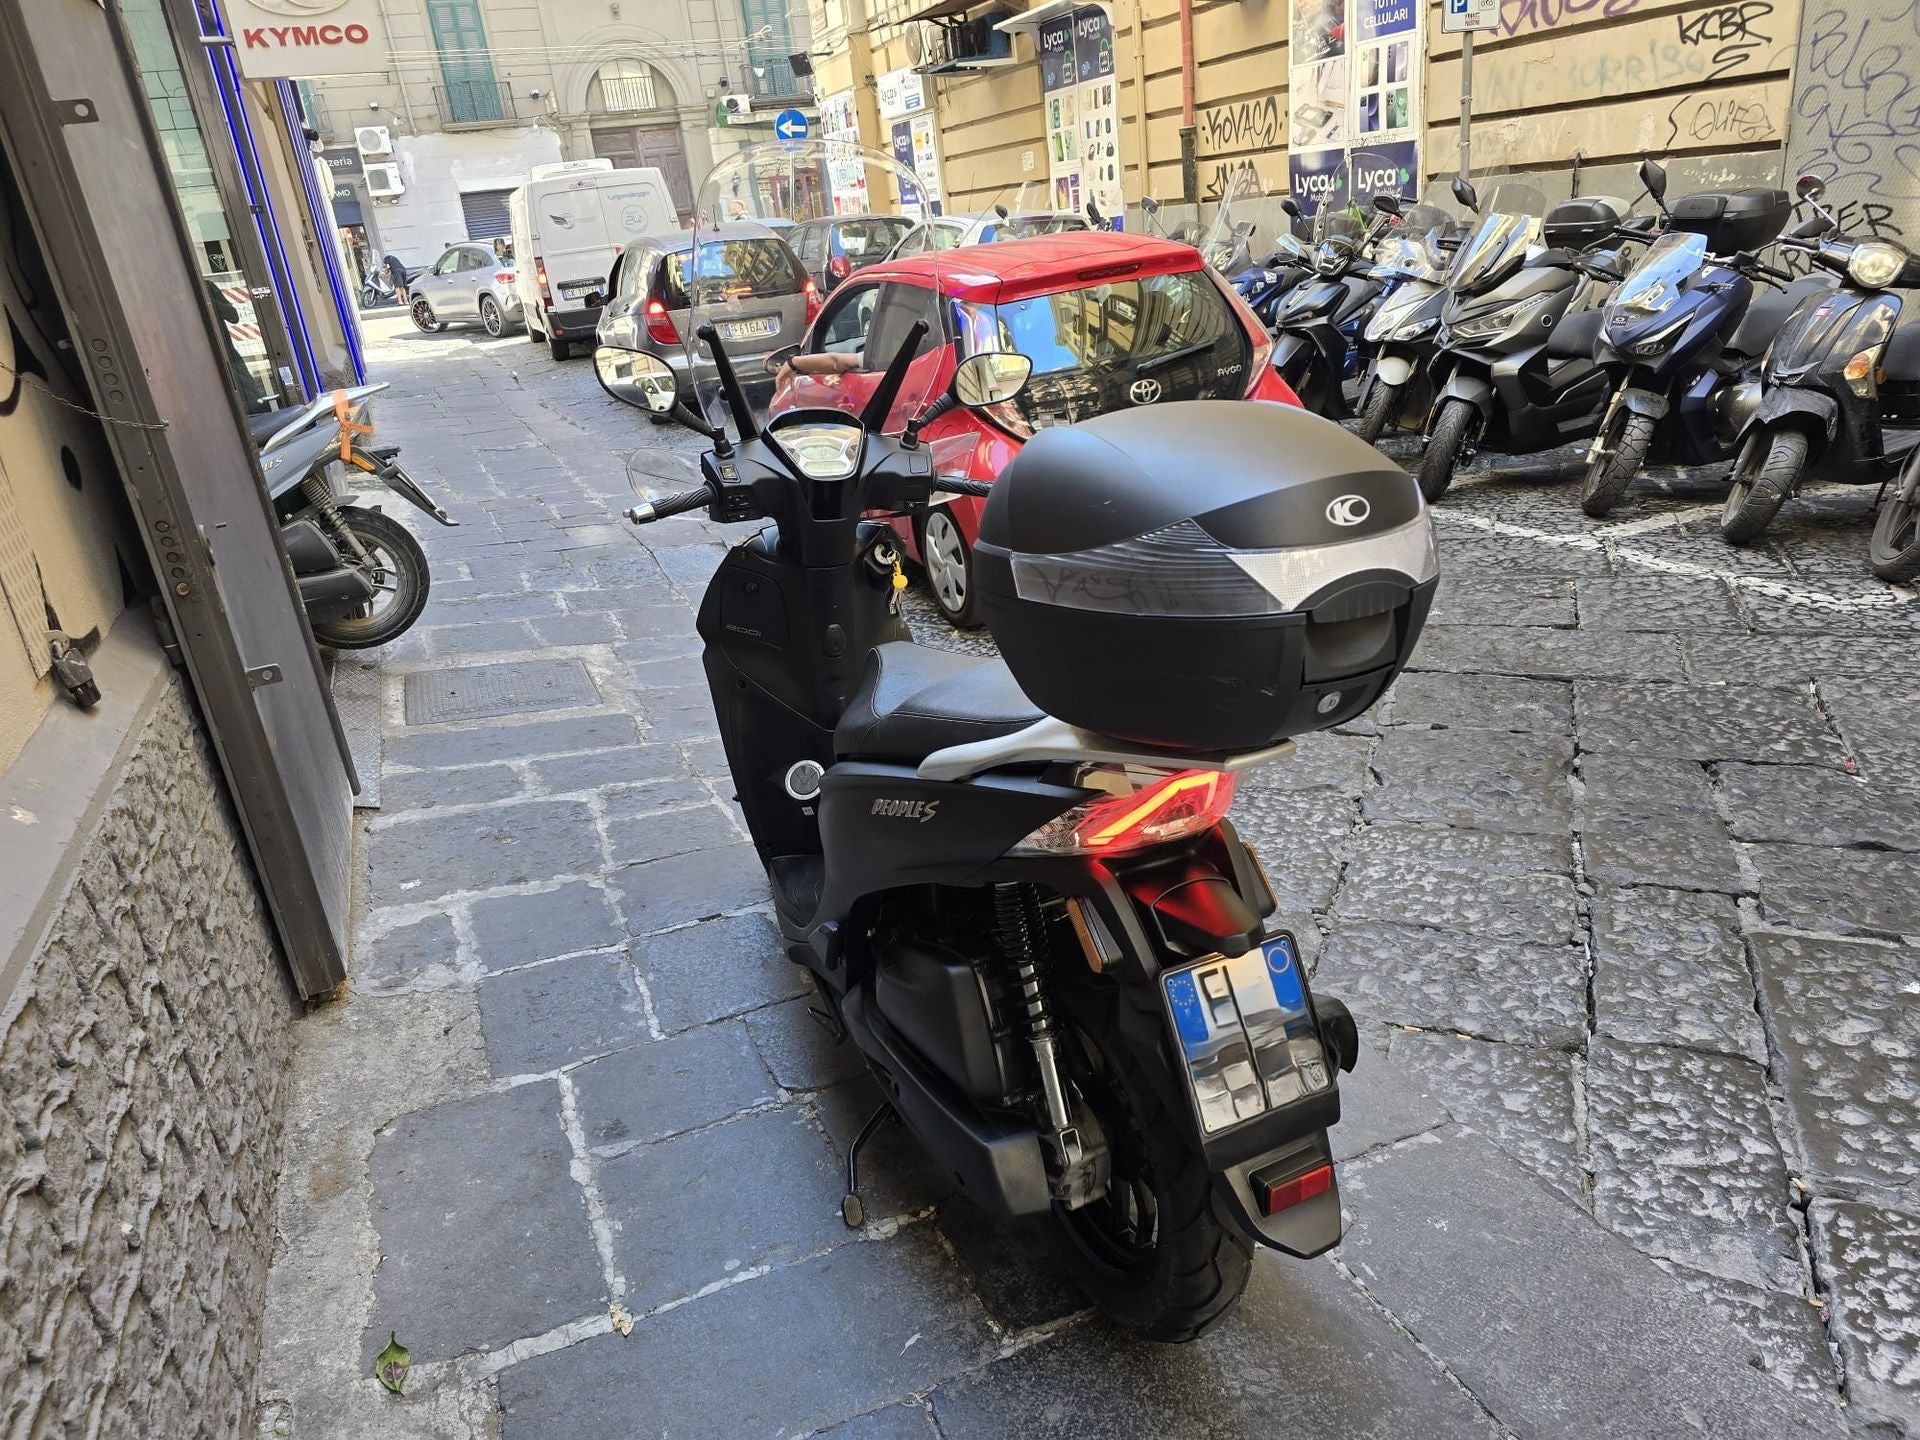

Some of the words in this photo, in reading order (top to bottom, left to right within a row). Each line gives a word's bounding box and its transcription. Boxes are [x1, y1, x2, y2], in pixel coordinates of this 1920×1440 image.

[1079, 17, 1099, 38] Lyca
[1364, 8, 1408, 28] CELLULARI
[243, 24, 368, 49] KYMCO
[1043, 31, 1064, 50] Lyca
[327, 156, 352, 167] zeria
[1358, 168, 1396, 193] Lyca
[1217, 364, 1242, 376] AYGO
